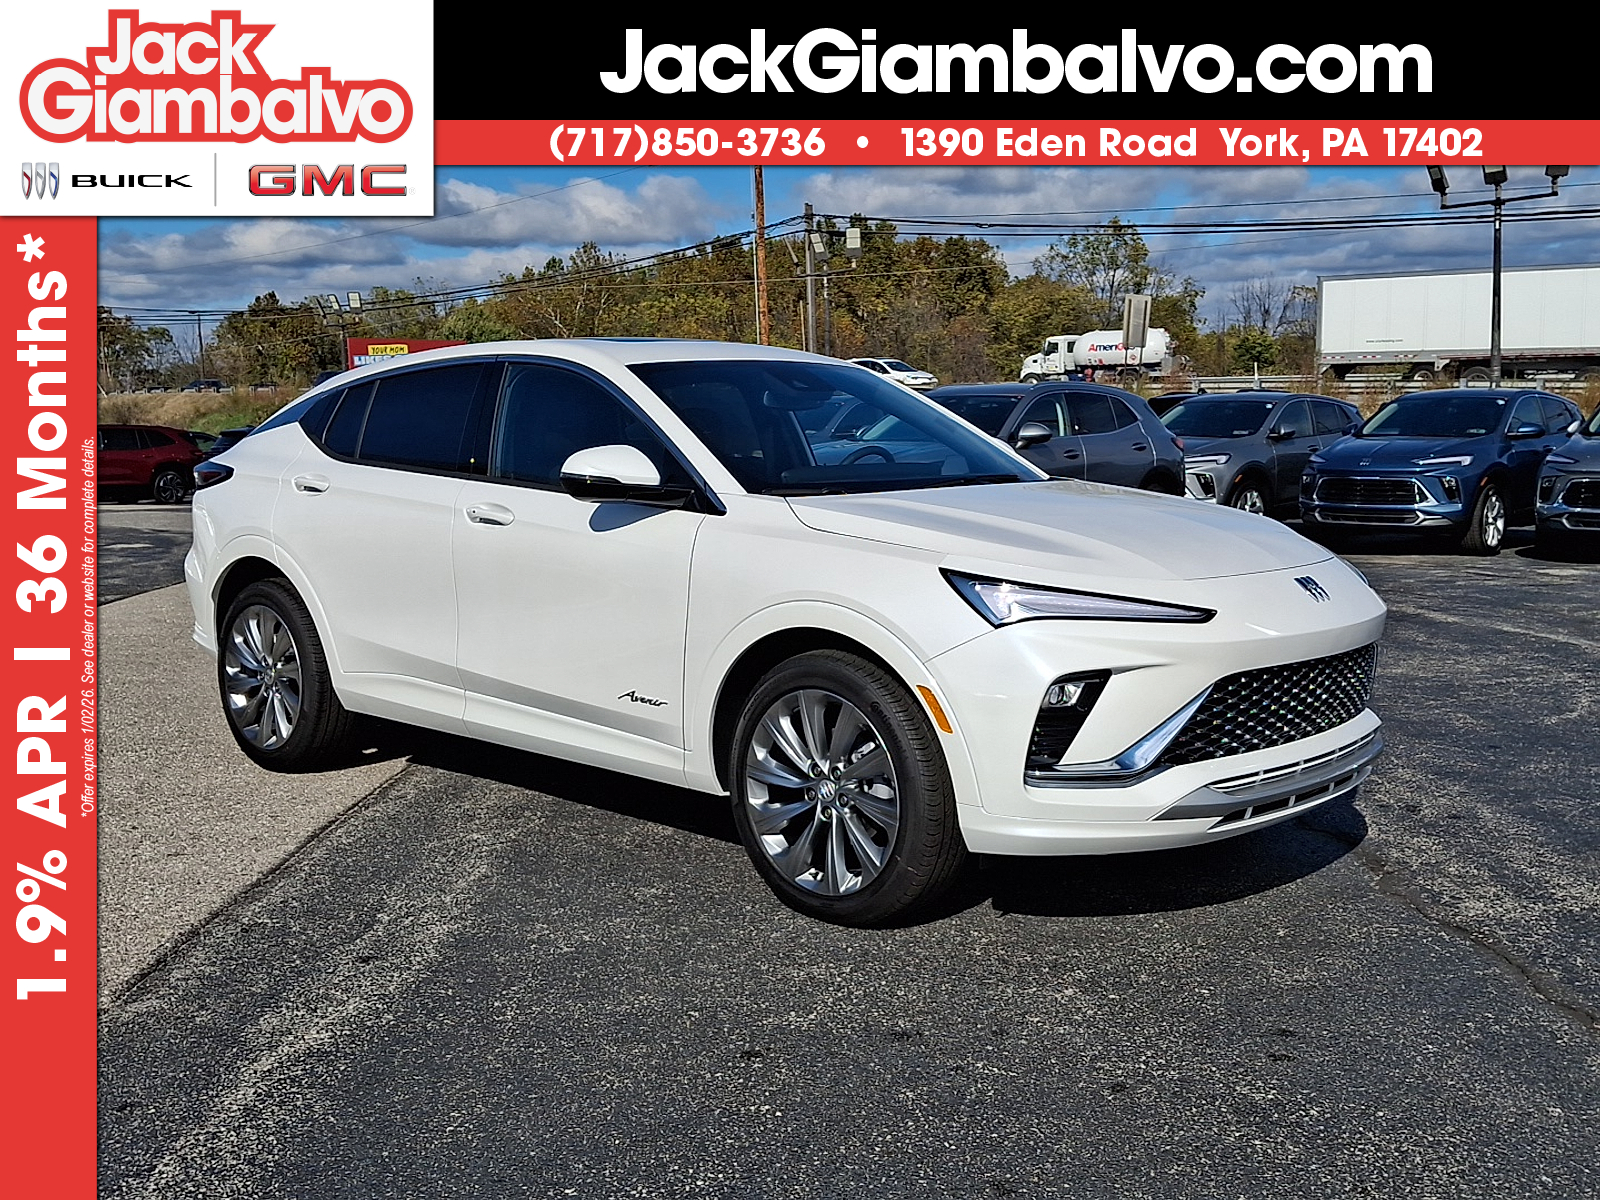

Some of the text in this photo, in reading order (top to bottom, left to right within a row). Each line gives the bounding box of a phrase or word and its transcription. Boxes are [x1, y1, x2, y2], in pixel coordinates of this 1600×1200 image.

[371, 346, 405, 355] YOUR MOM
[1088, 343, 1136, 352] AmeriG
